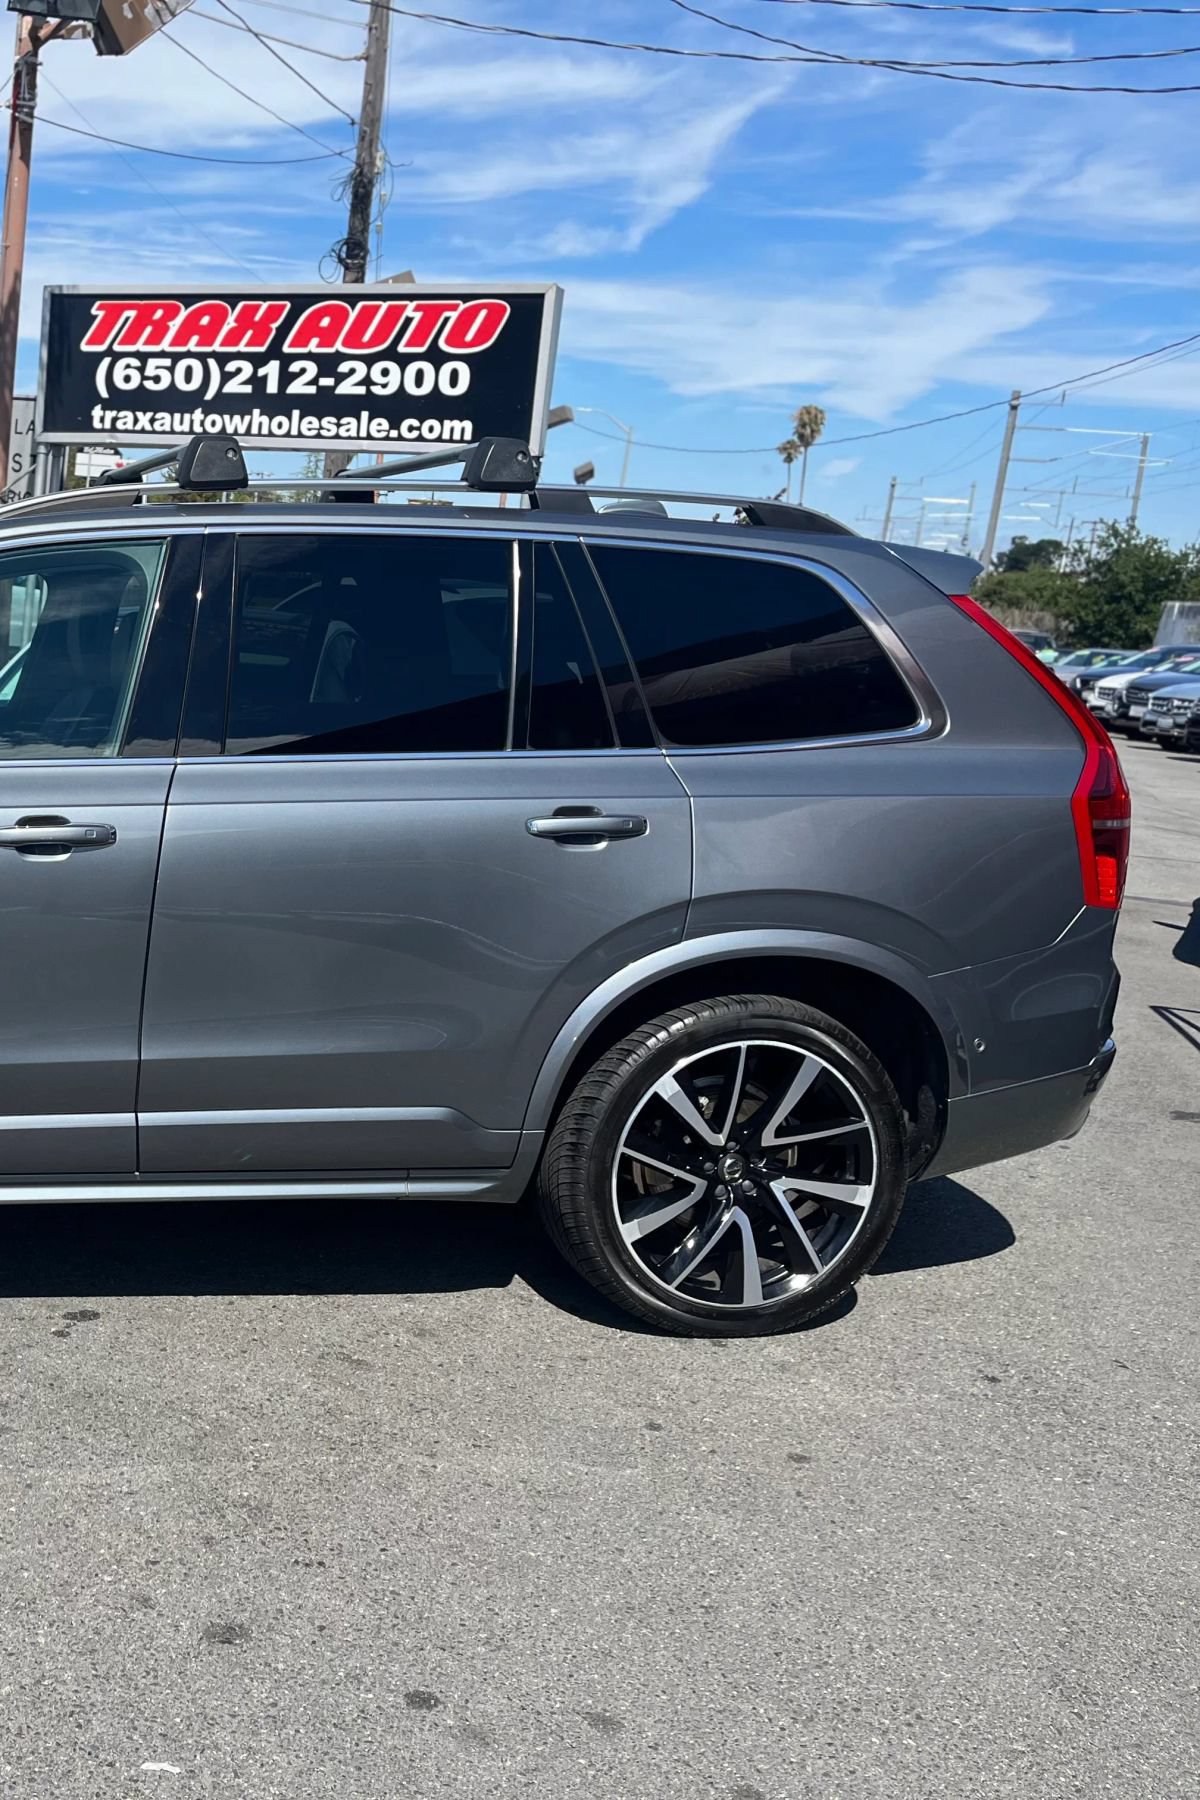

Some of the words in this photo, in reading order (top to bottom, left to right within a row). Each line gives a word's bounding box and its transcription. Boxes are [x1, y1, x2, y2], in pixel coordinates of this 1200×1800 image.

[80, 300, 291, 352] TRAX
[282, 299, 511, 354] AUTO
[95, 356, 472, 400] (650)212-2900
[90, 404, 474, 441] traxautowholesale.com
